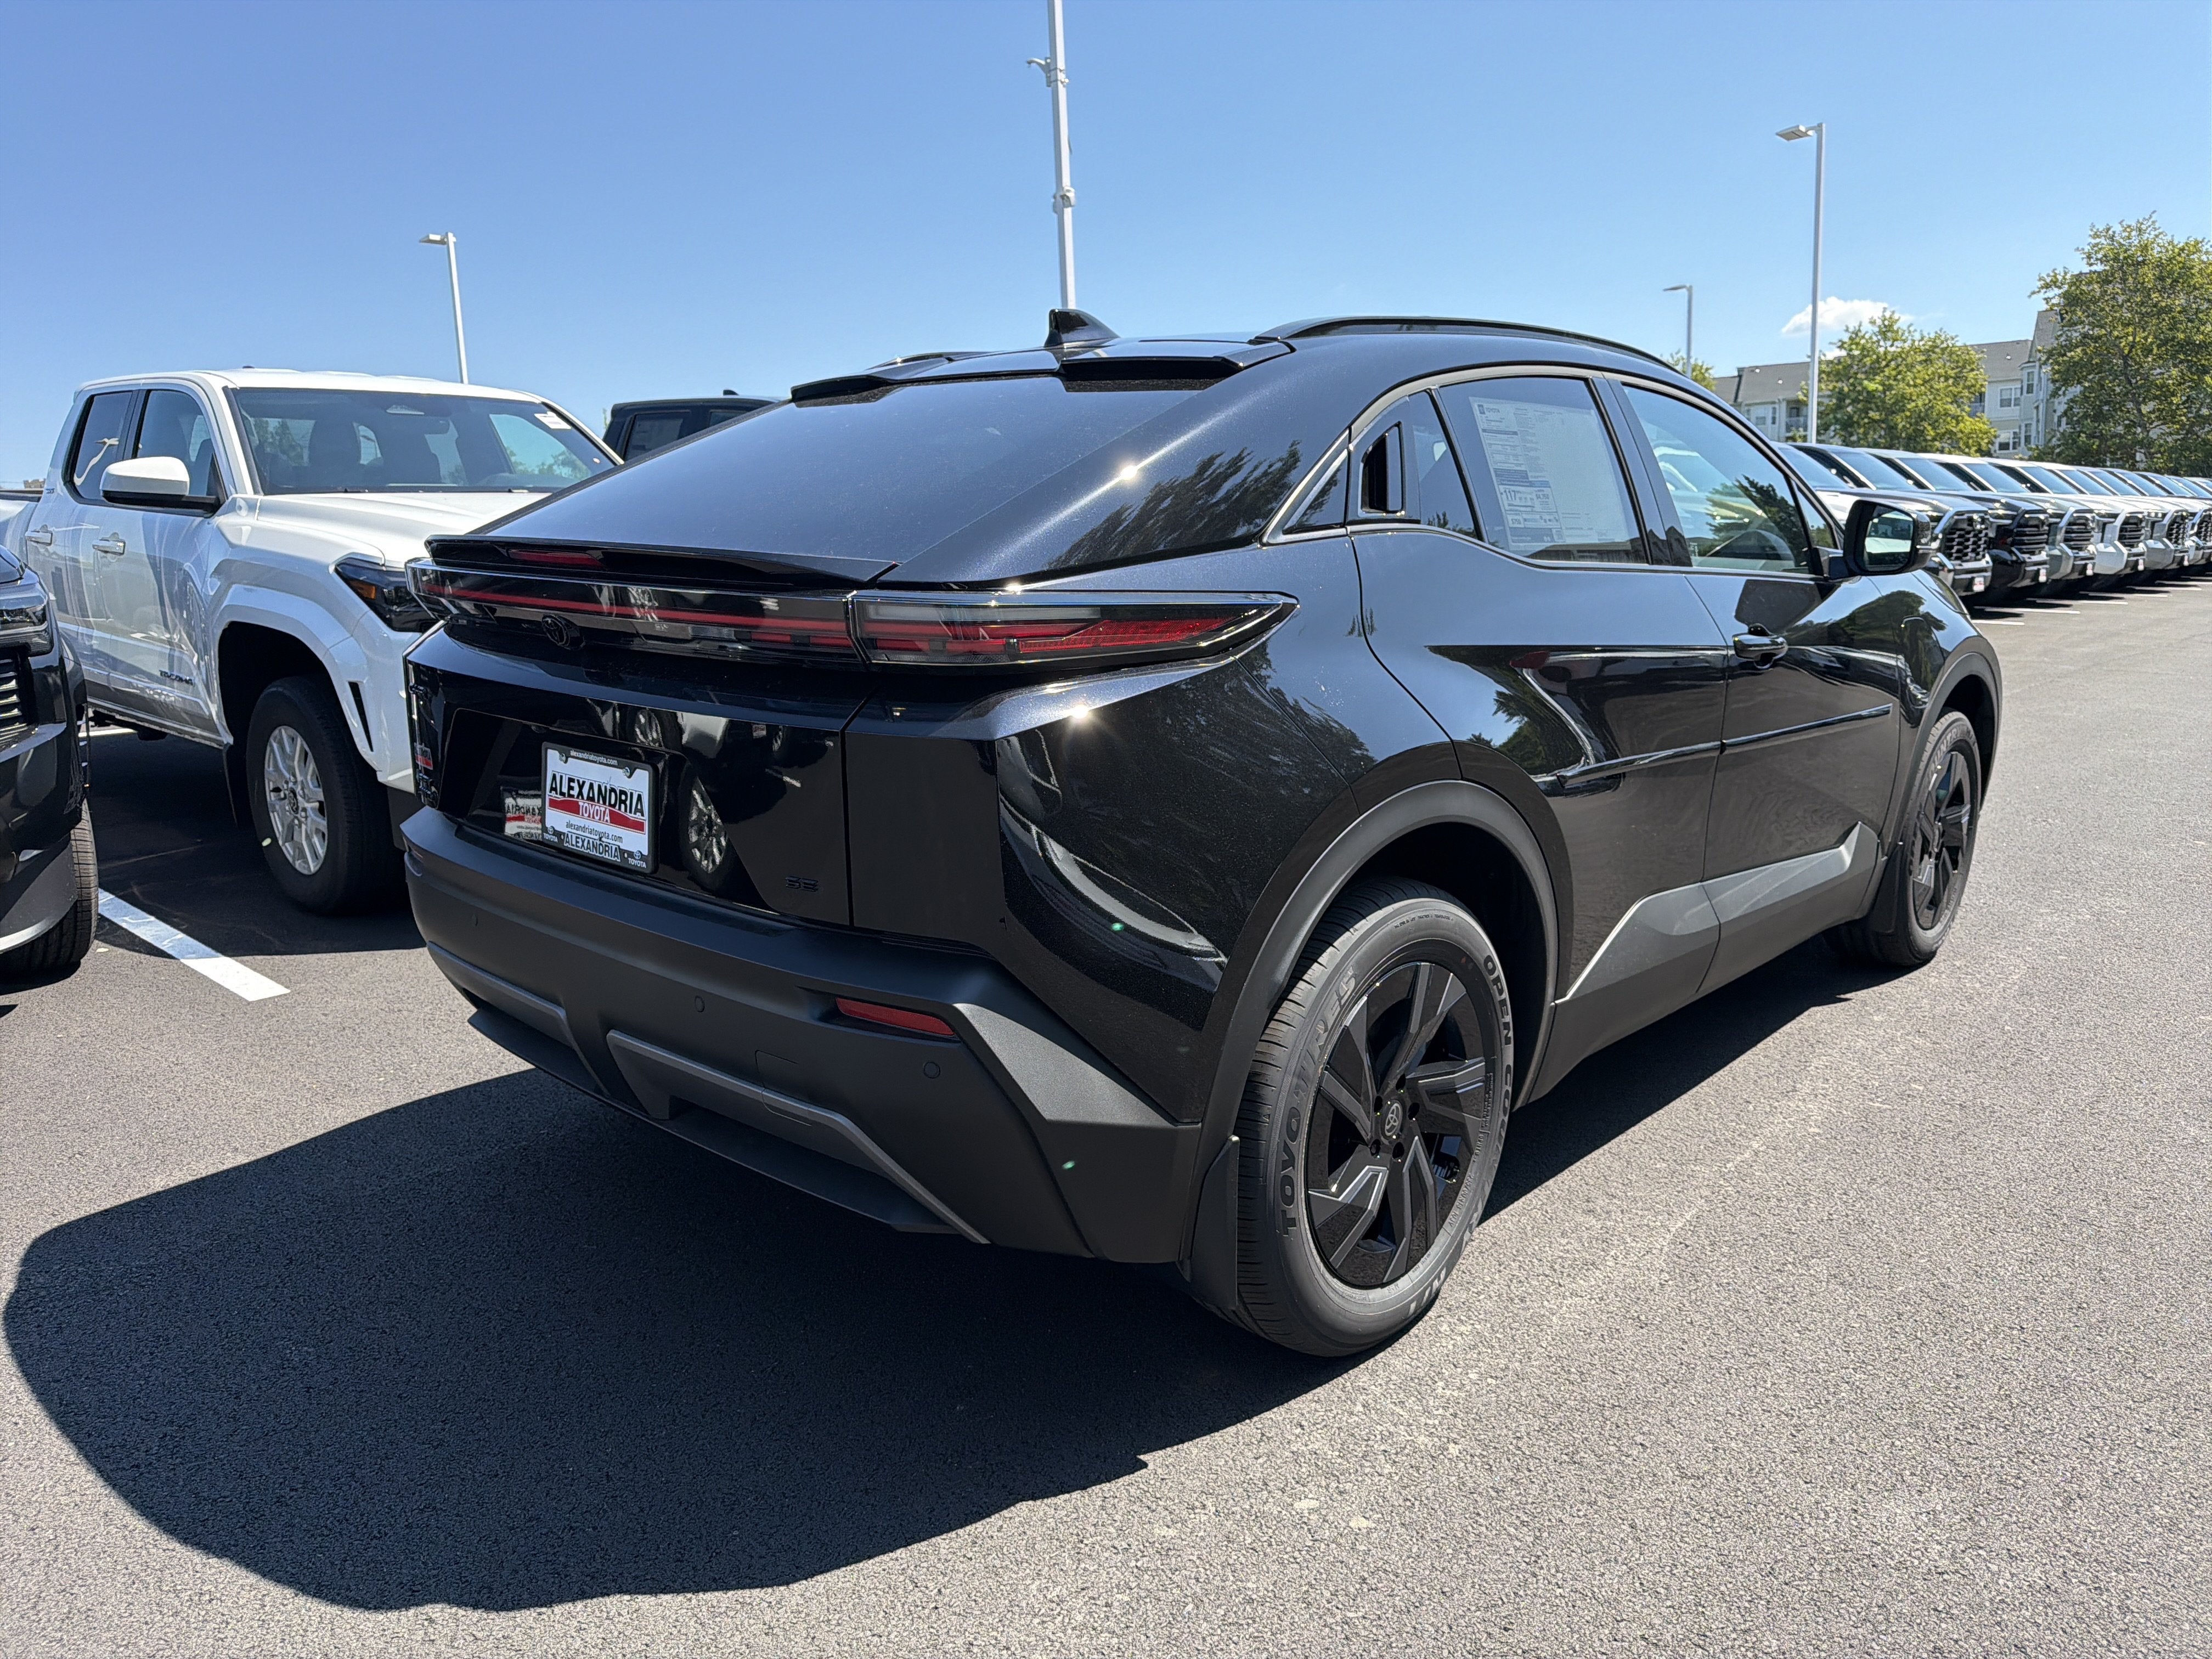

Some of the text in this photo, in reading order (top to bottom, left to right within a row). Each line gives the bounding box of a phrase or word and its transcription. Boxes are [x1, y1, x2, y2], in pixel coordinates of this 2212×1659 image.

[159, 669, 193, 686] TACOMA
[570, 749, 618, 766] alexandriatoyota.com
[549, 772, 645, 817] ALEXANDRIA
[578, 802, 611, 823] TOYOTA
[543, 833, 558, 843] TOYOTA
[565, 820, 623, 844] alexandriatoyota.com
[564, 832, 621, 862] ALEXANDRIA
[628, 857, 647, 868] TOYOTA
[1483, 955, 1511, 1046] OPEN
[1280, 1106, 1301, 1237] TOYO
